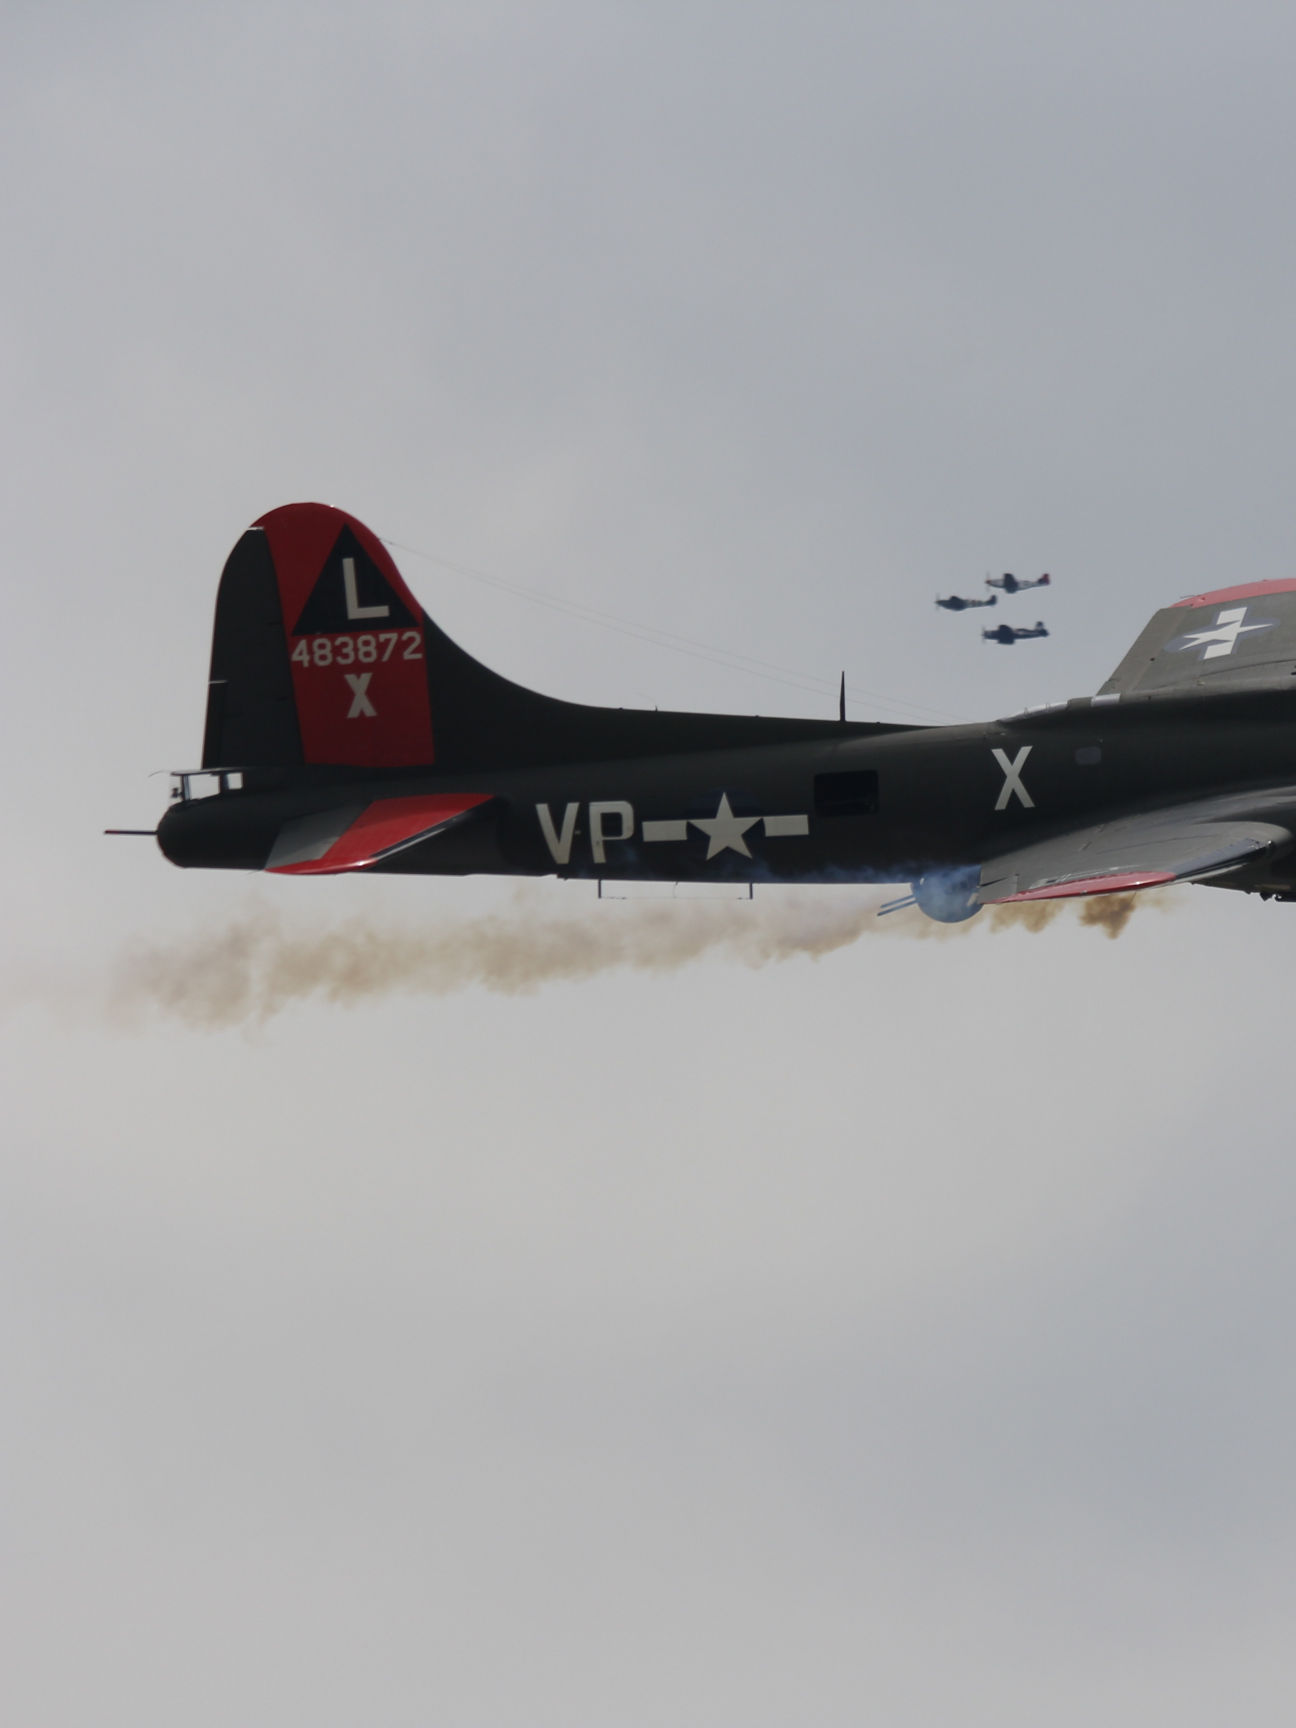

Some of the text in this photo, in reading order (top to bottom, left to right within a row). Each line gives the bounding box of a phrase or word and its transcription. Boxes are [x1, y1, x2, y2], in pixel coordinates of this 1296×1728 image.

[342, 557, 390, 620] L
[291, 631, 423, 668] 483872
[344, 672, 378, 718] X
[991, 745, 1036, 811] X
[535, 800, 635, 865] VP
